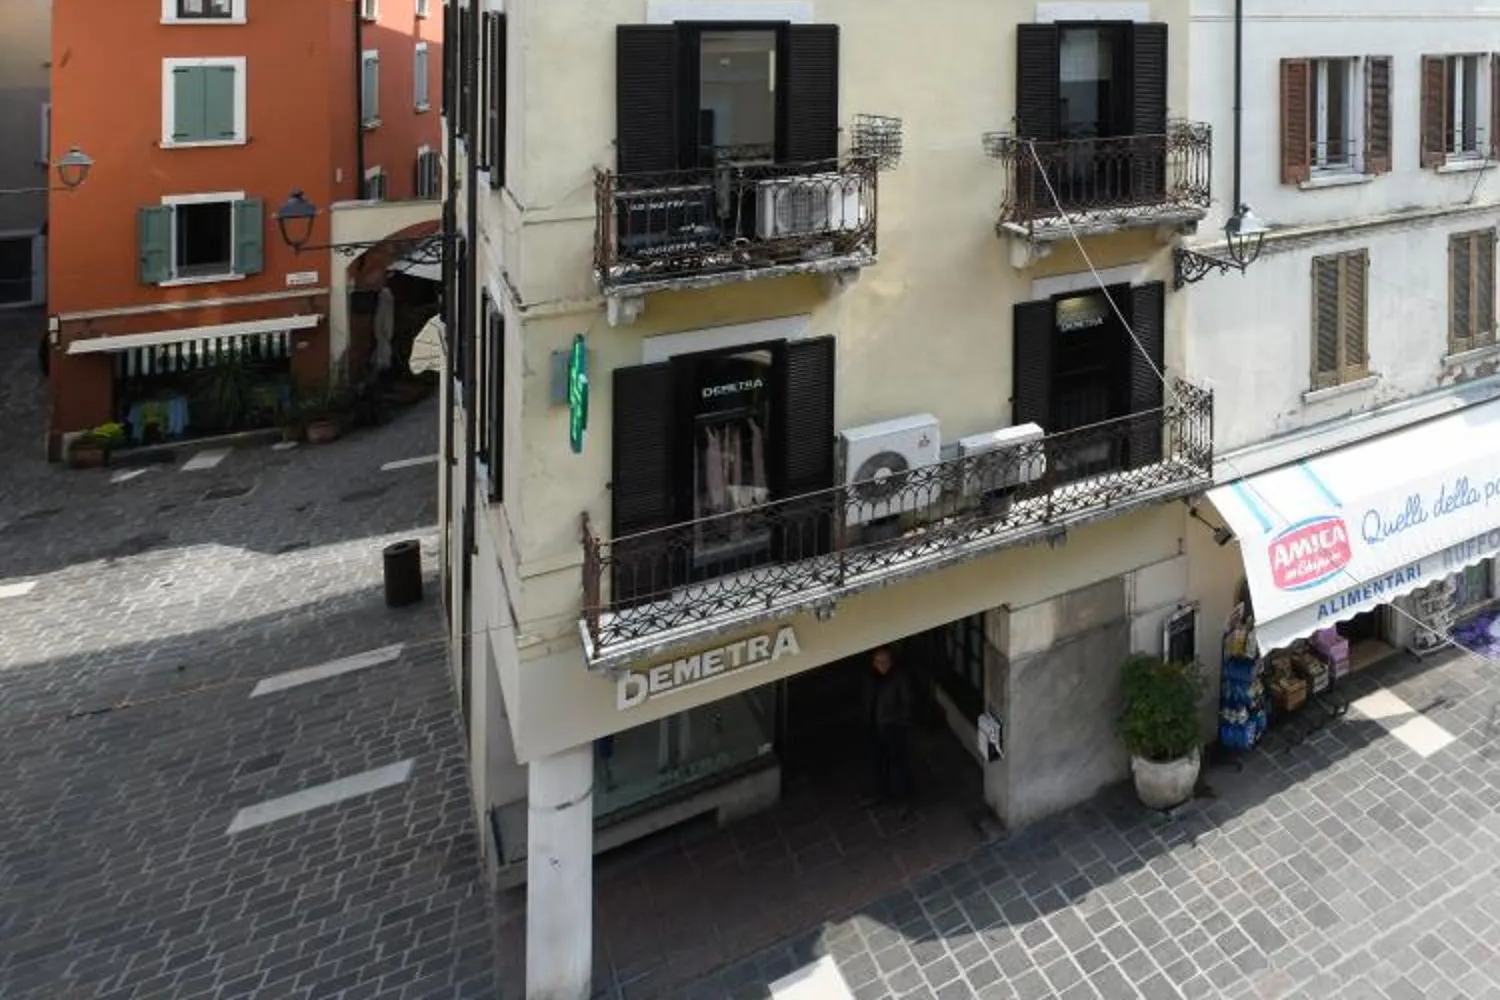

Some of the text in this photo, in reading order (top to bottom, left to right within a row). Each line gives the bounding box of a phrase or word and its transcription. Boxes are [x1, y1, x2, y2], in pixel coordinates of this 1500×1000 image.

[702, 378, 763, 398] DEMETRA
[1361, 492, 1428, 545] Quelli
[1433, 475, 1481, 519] della
[1274, 524, 1346, 570] AMICA
[1316, 563, 1422, 621] ALIMENTARI
[617, 626, 801, 711] DEMETRA
